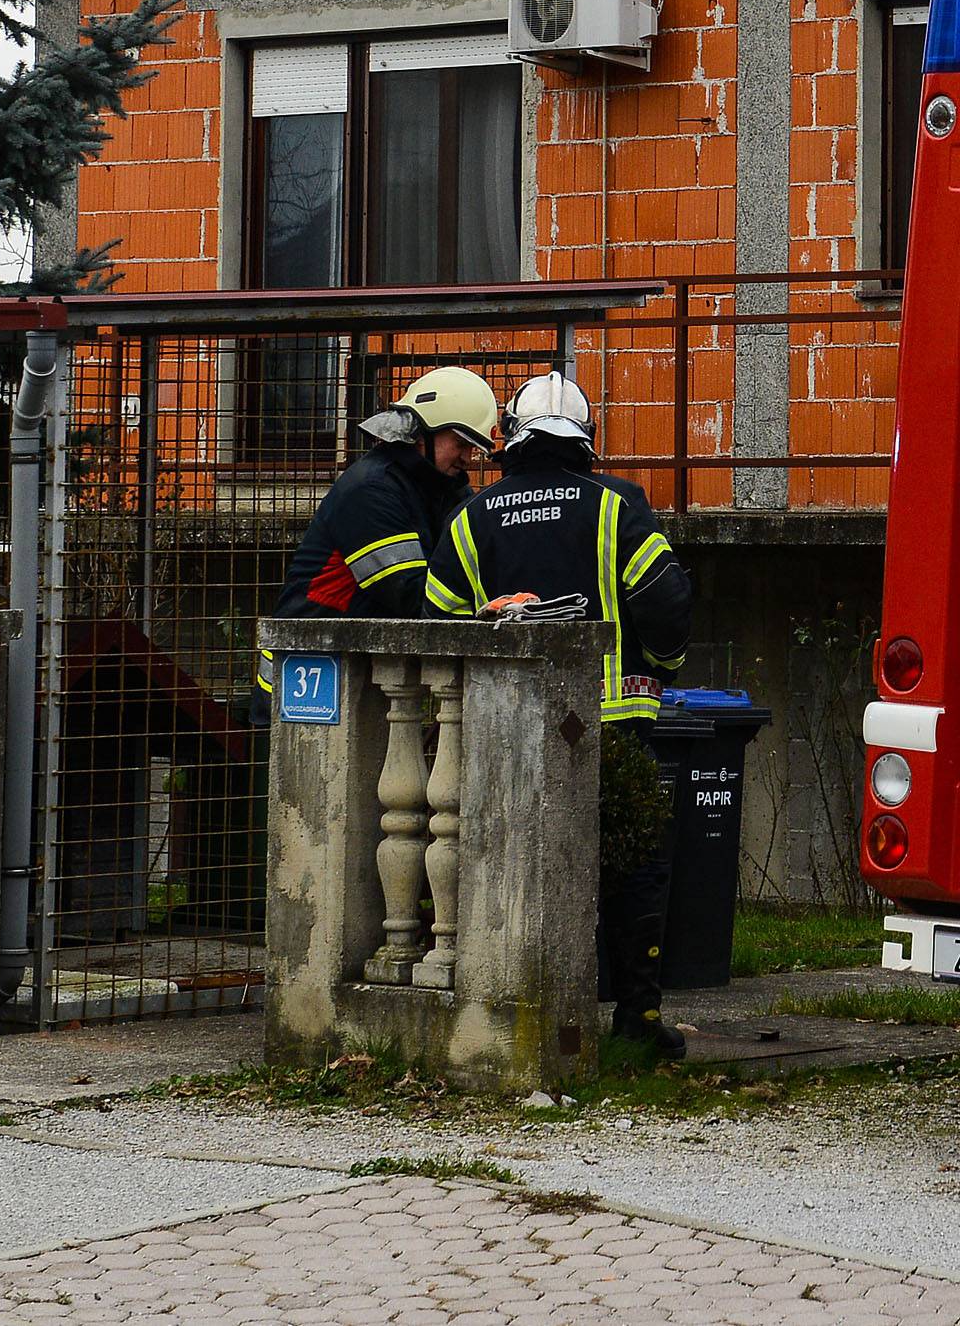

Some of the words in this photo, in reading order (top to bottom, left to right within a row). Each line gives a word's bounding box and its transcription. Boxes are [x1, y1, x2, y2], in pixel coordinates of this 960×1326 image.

[485, 487, 581, 510] VATROGASCI
[501, 506, 561, 527] ZAGREB
[293, 666, 322, 699] 37
[696, 791, 732, 806] PAPIR
